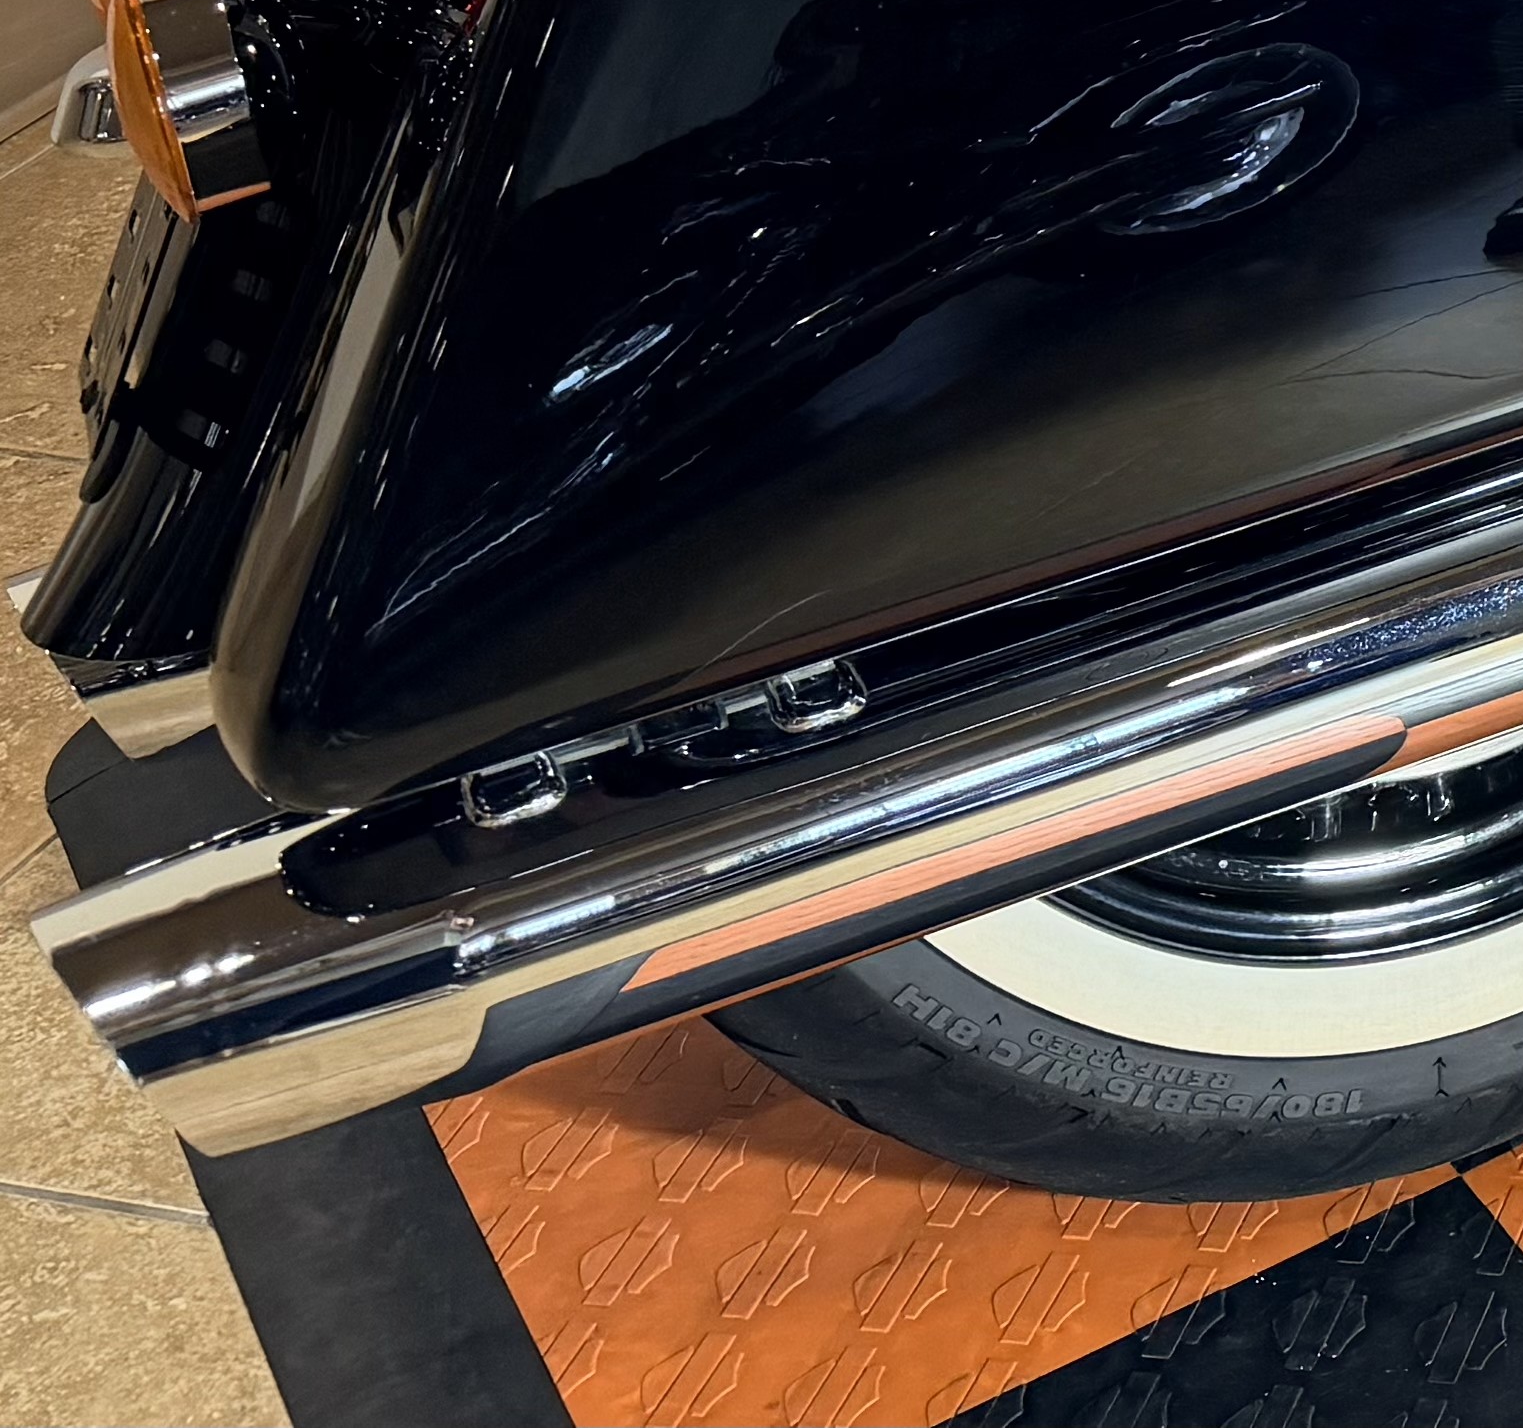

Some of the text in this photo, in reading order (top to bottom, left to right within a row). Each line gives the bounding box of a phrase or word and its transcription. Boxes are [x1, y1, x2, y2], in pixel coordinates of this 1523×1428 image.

[891, 983, 1364, 1120] 180/65B16 M/C 81H
[1027, 1027, 1234, 1091] REINFORCED
